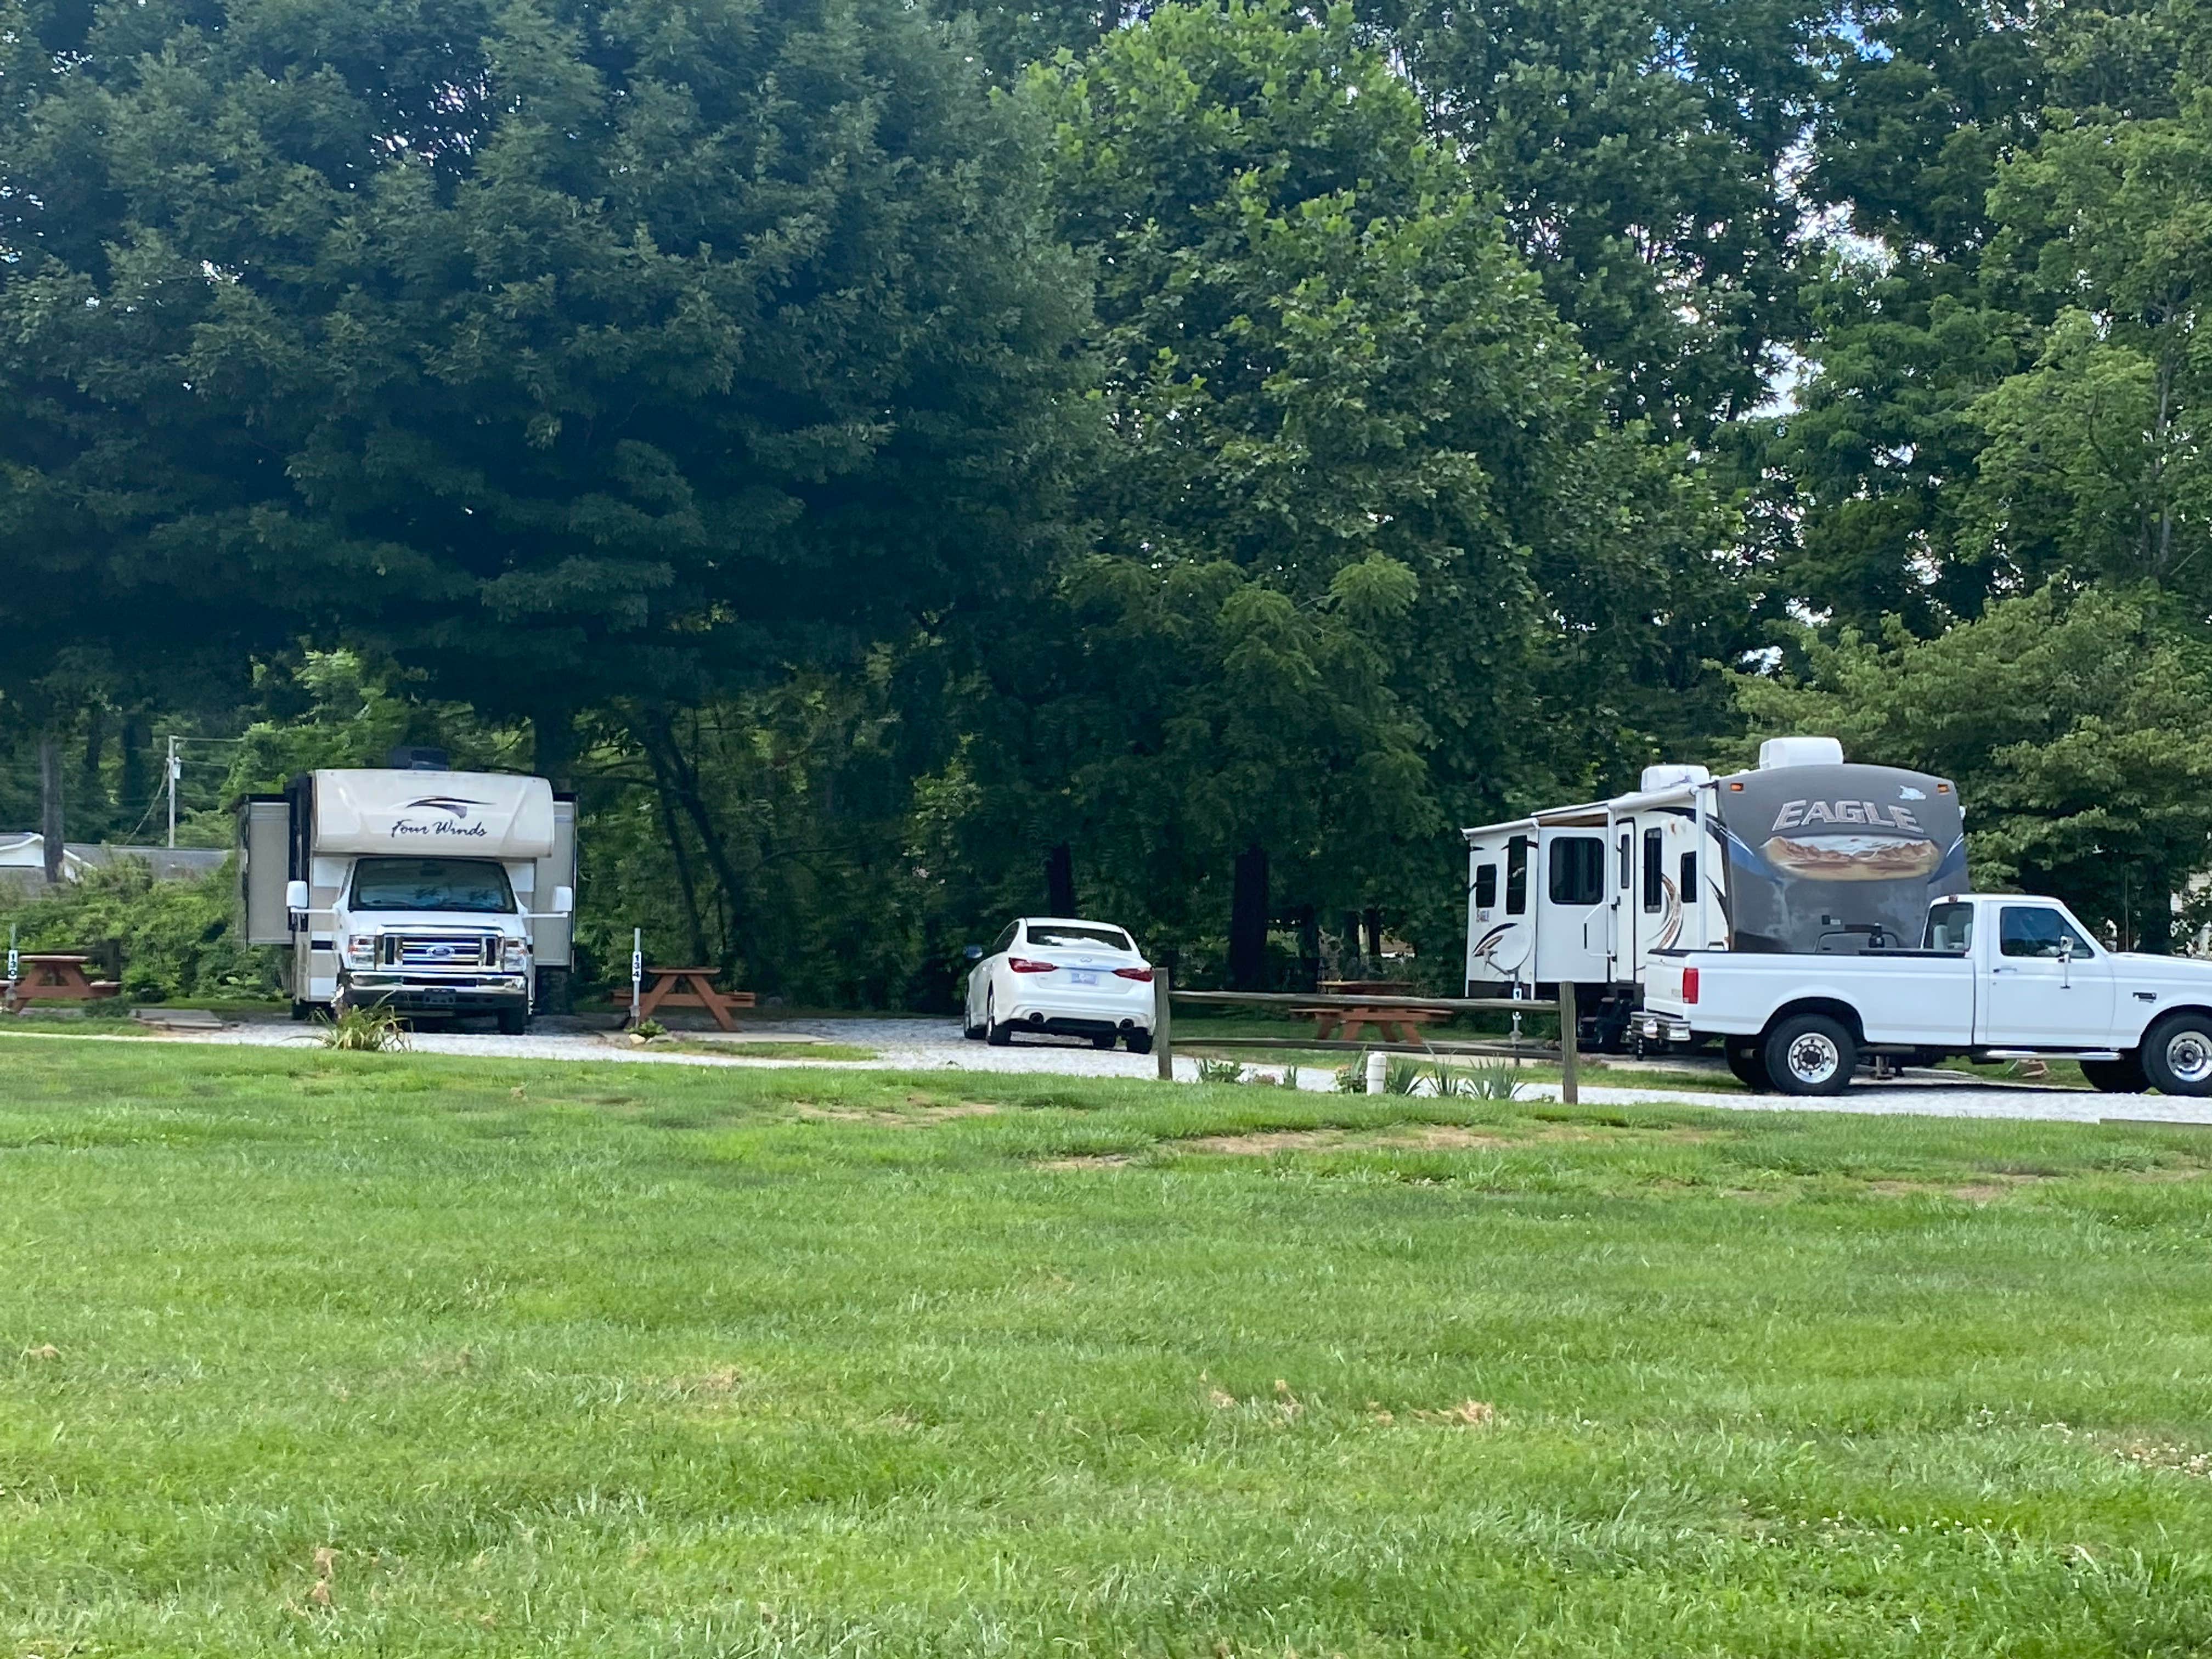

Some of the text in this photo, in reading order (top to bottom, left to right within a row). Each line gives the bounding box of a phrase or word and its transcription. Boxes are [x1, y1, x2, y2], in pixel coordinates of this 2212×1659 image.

[391, 819, 488, 838] Four Winds
[1771, 799, 1924, 834] EAGLE
